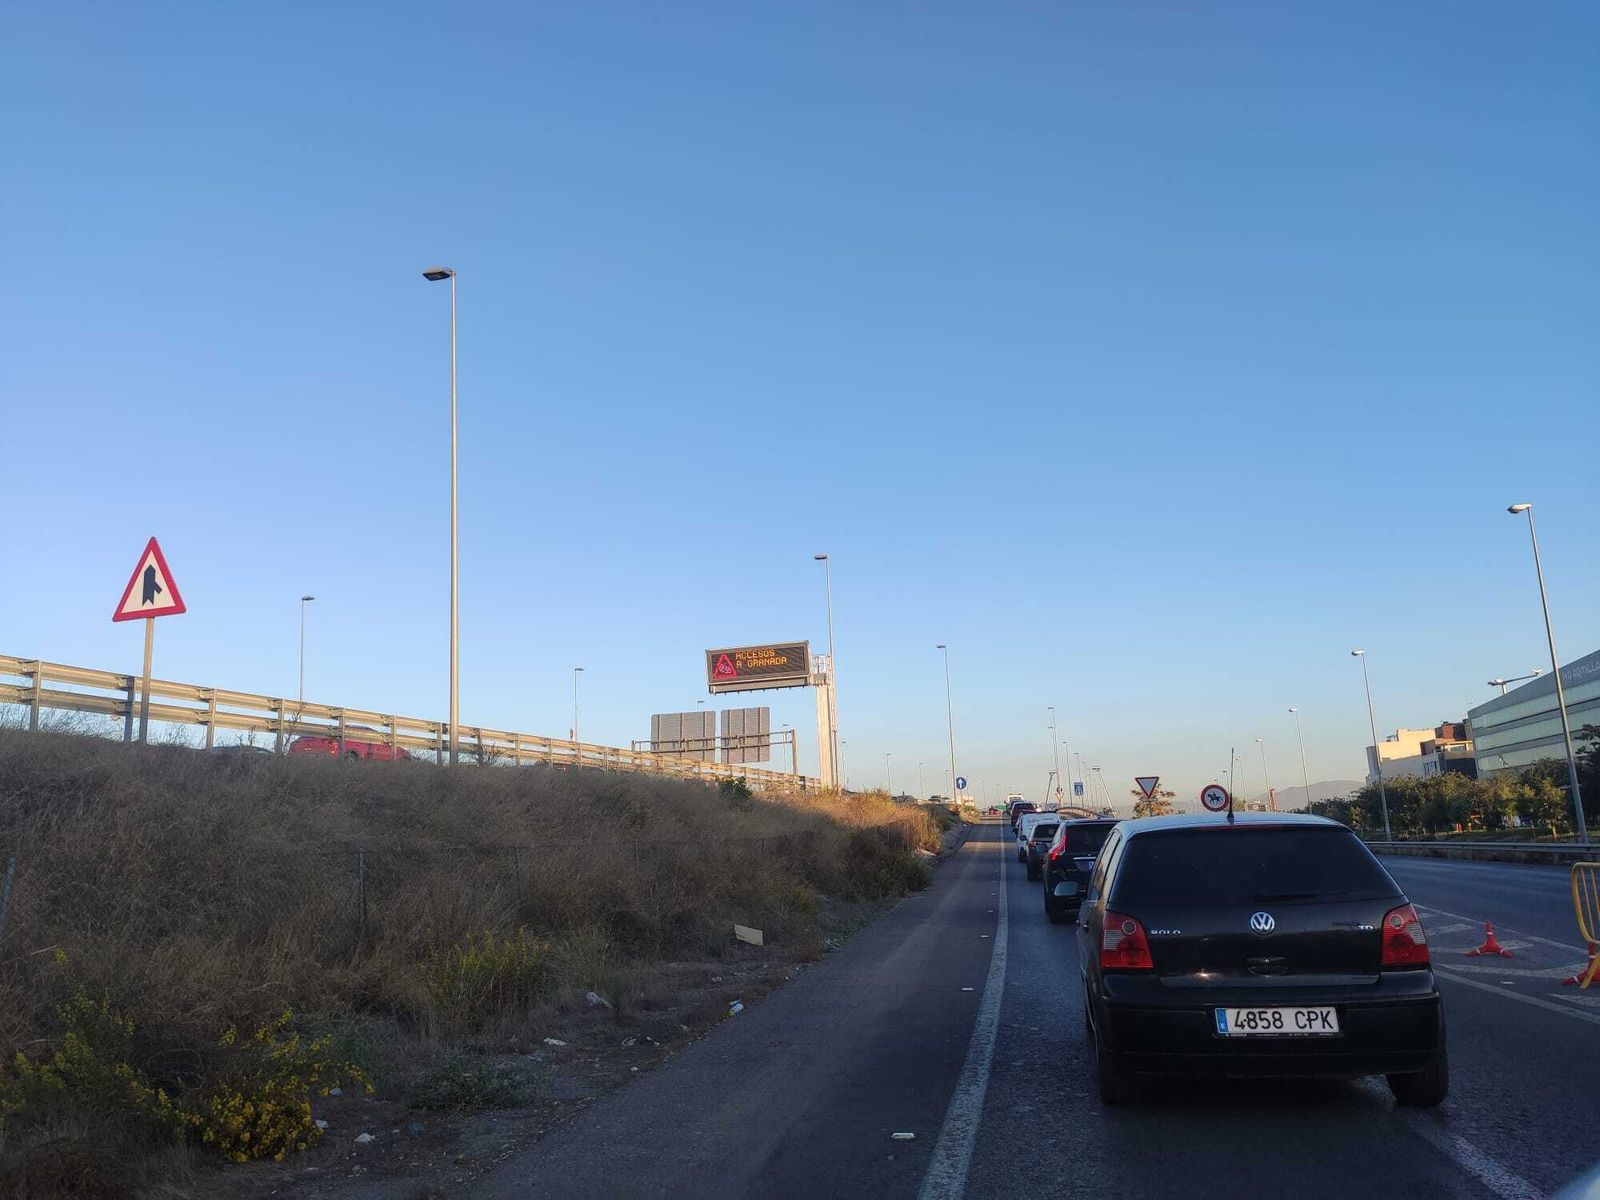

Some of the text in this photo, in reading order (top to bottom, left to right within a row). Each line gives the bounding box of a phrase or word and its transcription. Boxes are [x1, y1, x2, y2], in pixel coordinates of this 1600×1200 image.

[735, 649, 776, 660] ACCESOS
[736, 656, 788, 669] A GRANADA
[1234, 1010, 1334, 1030] 4858 CPK
